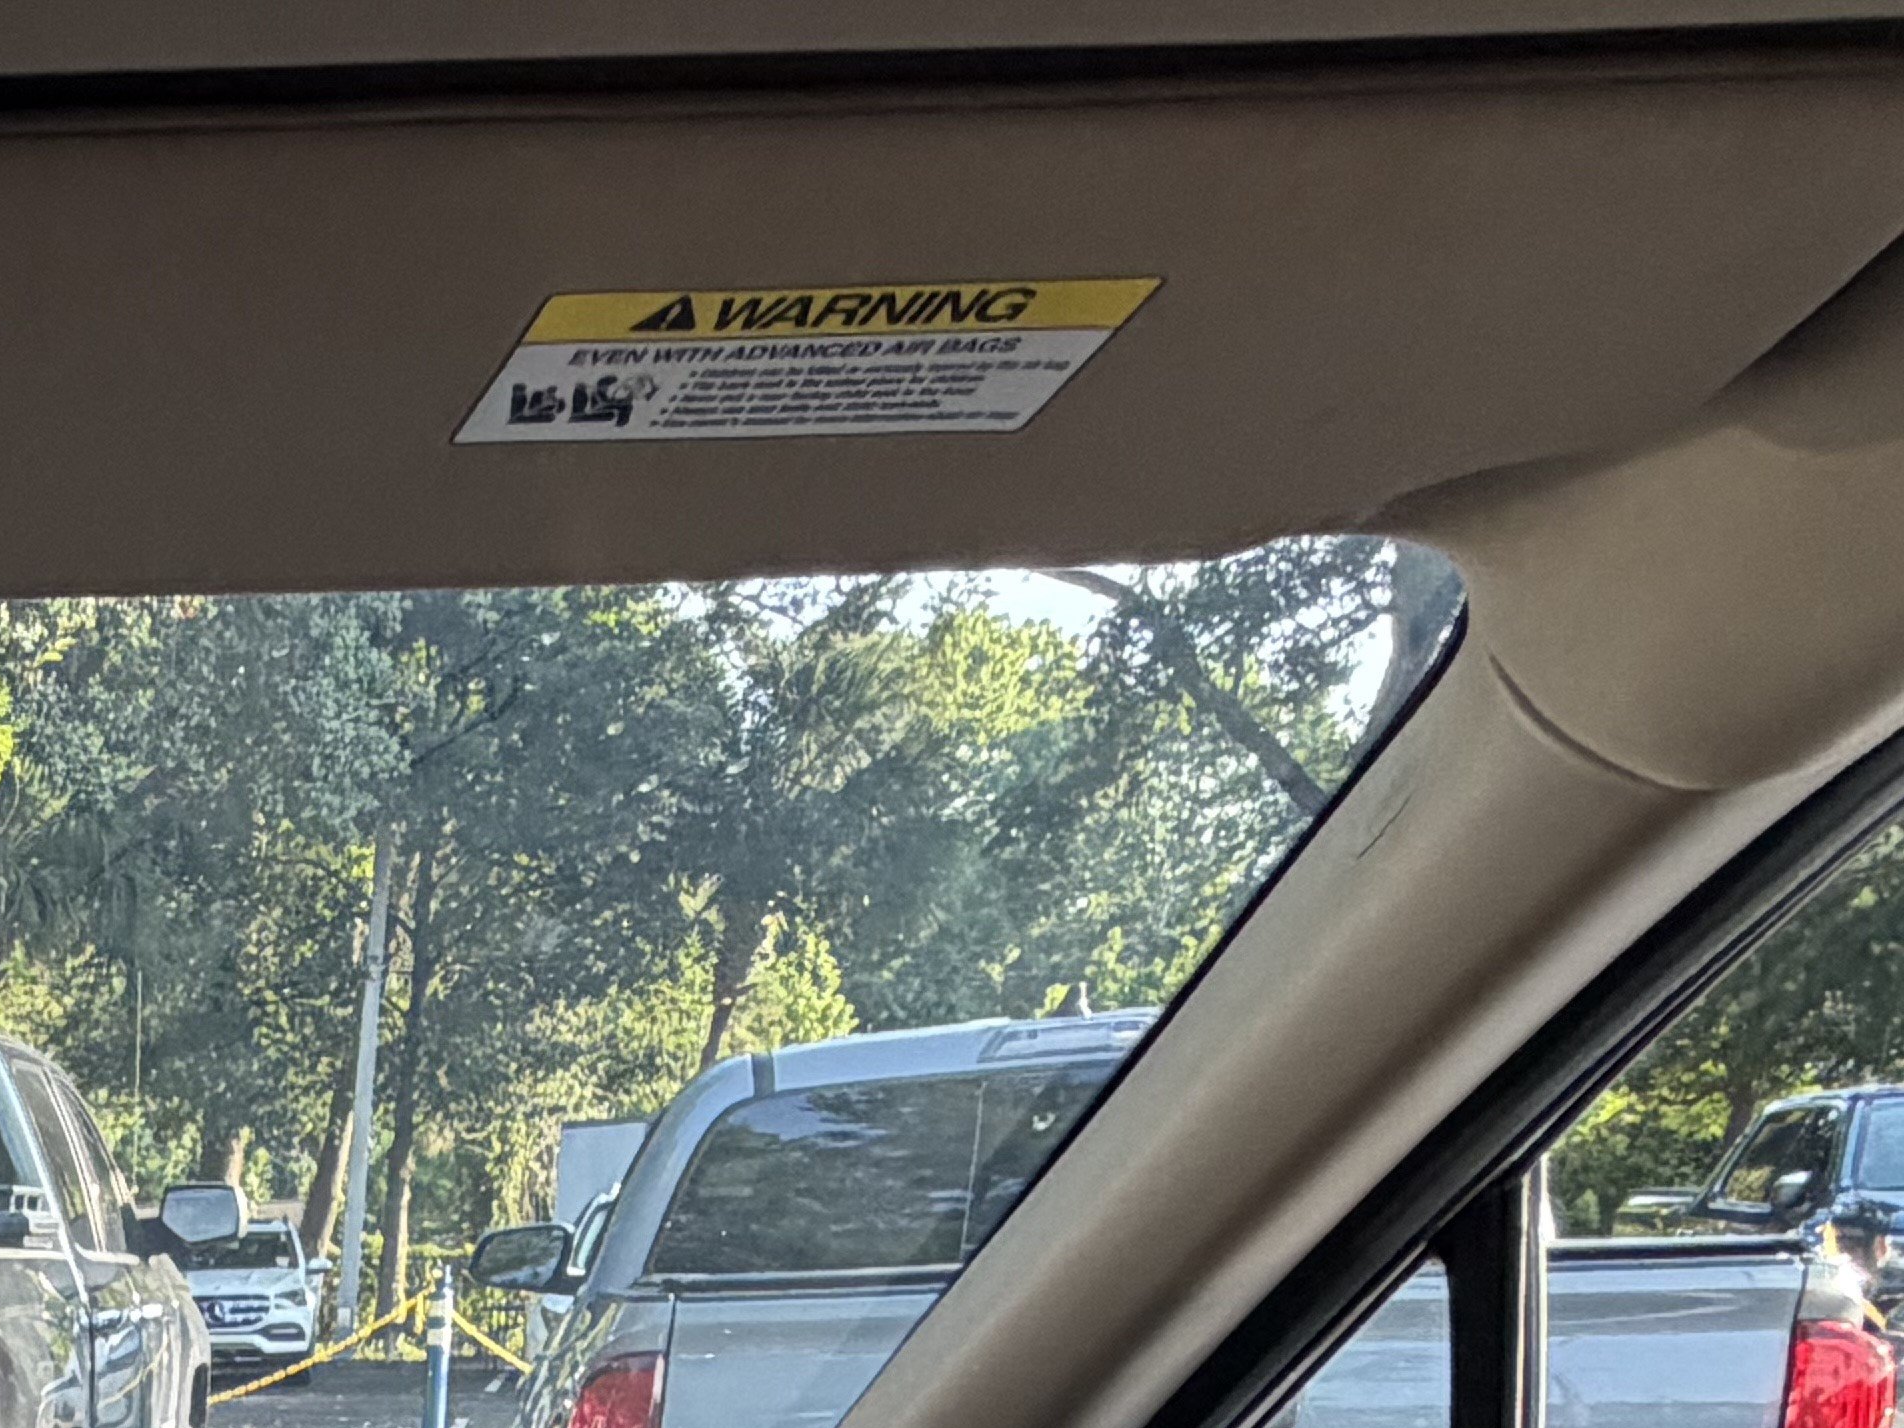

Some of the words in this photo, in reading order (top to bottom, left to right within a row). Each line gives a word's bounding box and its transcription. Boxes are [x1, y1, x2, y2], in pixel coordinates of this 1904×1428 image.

[714, 288, 1038, 331] WARNING
[569, 347, 651, 368] EVEN
[652, 345, 724, 365] WITH
[727, 340, 882, 363] ADVANCED
[884, 339, 932, 357] AIR
[937, 336, 1022, 355] BAGS
